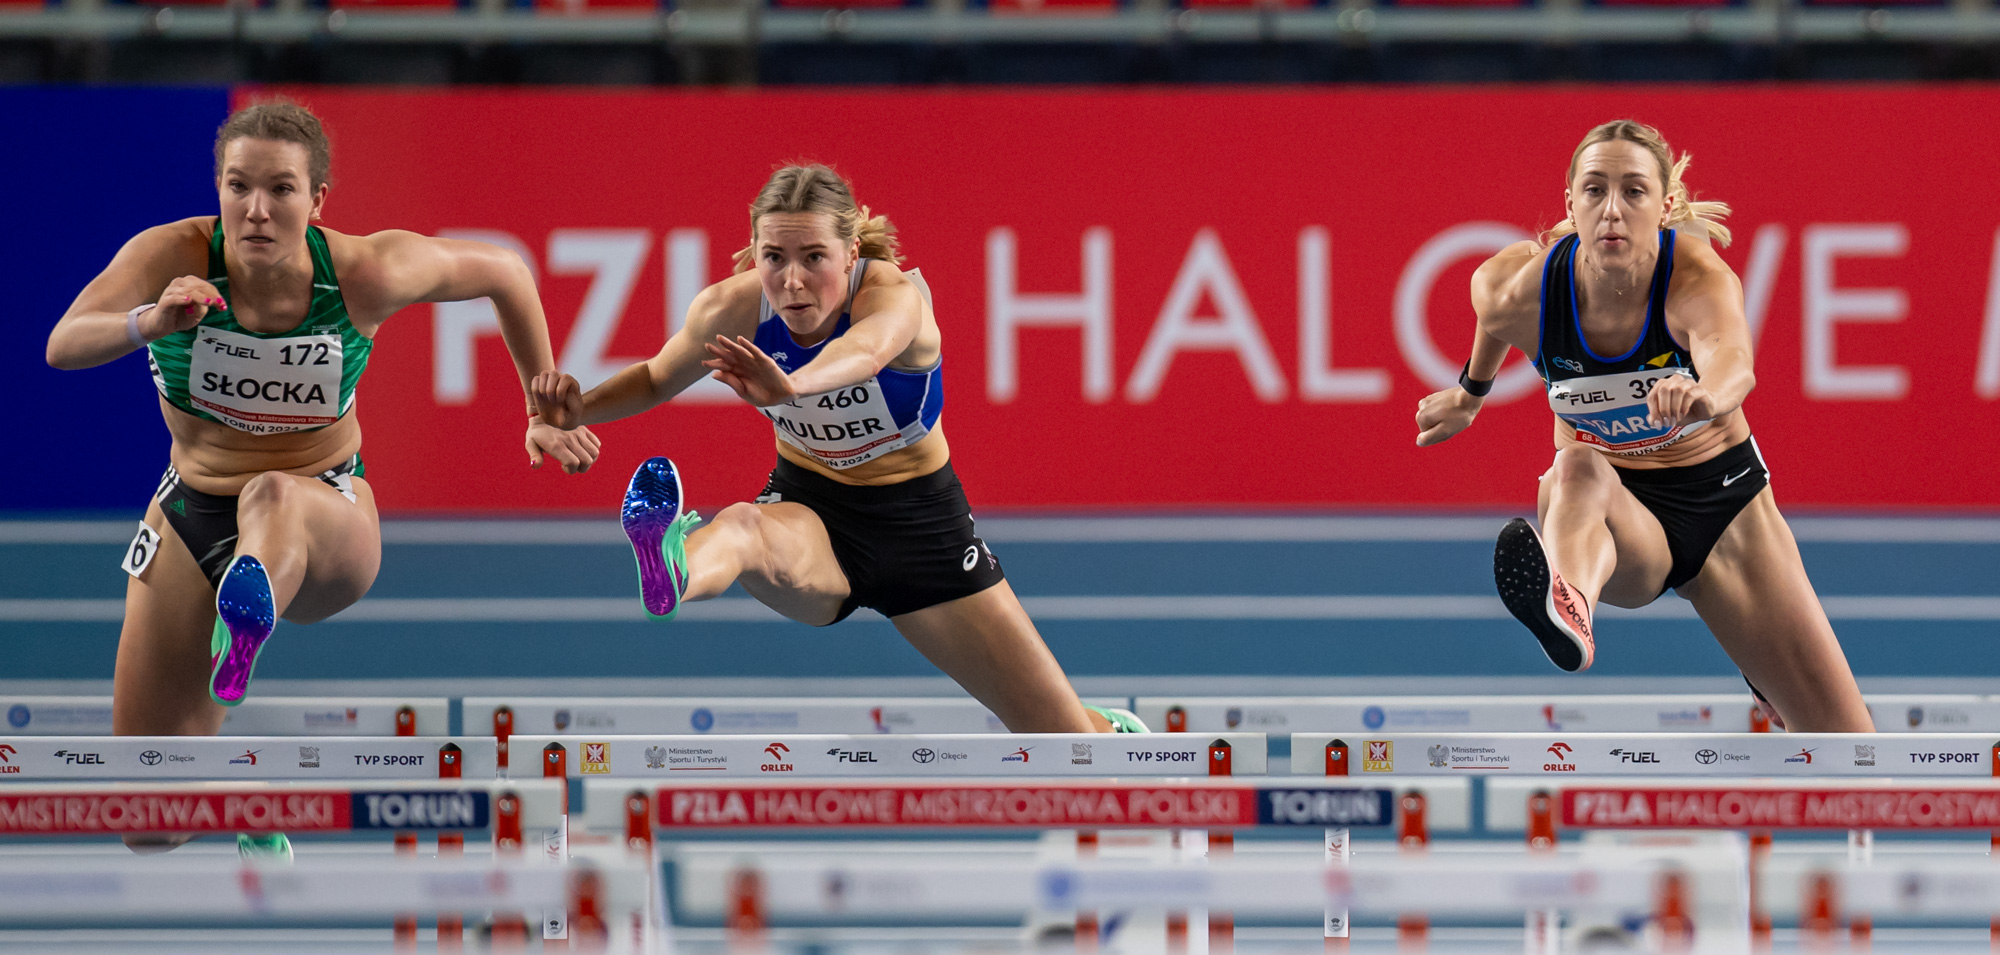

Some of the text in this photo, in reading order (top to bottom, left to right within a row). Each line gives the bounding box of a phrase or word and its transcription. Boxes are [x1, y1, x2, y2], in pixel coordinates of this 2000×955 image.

[432, 228, 722, 403] PZL
[985, 221, 1910, 405] HALOE
[215, 342, 261, 360] FUEL
[280, 343, 329, 366] 172
[1552, 356, 1584, 373] esa
[201, 371, 326, 404] SŁOCKA
[1629, 375, 1672, 399] 38
[817, 386, 869, 410] 460
[1570, 390, 1615, 406] FUEL
[227, 410, 257, 420] Halowe
[258, 414, 307, 423] Mistrzostwa
[222, 416, 265, 432] TORUŃ
[764, 408, 885, 441] MULDER
[1582, 433, 1594, 442] 68.
[841, 453, 871, 466] 2024
[130, 528, 150, 571] 6
[1556, 574, 1595, 650] new balanc
[66, 754, 105, 764] FUEL
[169, 753, 195, 763] Okęcie
[355, 755, 424, 766] TVP SPORT
[669, 756, 692, 764] Sportu
[697, 756, 727, 764] Turystyki
[826, 748, 878, 762] 4F FUEL
[941, 752, 968, 761] Okęcie
[1127, 751, 1197, 762] TVP SPORT
[1452, 755, 1475, 763] Sportu
[1480, 755, 1510, 764] Turystyki
[1622, 752, 1660, 763] FUEL
[1724, 753, 1750, 762] Okęcie
[1909, 753, 1980, 763] TVP SPORT
[581, 763, 610, 773] PZLA
[761, 764, 793, 772] ORLEN
[1364, 761, 1391, 771] PZLA
[224, 795, 334, 828] POLSKI
[672, 790, 748, 823] PZLA
[753, 790, 896, 823] HALOWE
[1128, 790, 1239, 823] POLSKI
[1573, 791, 1651, 824] PZLA
[1655, 791, 1799, 825] HALOWE
